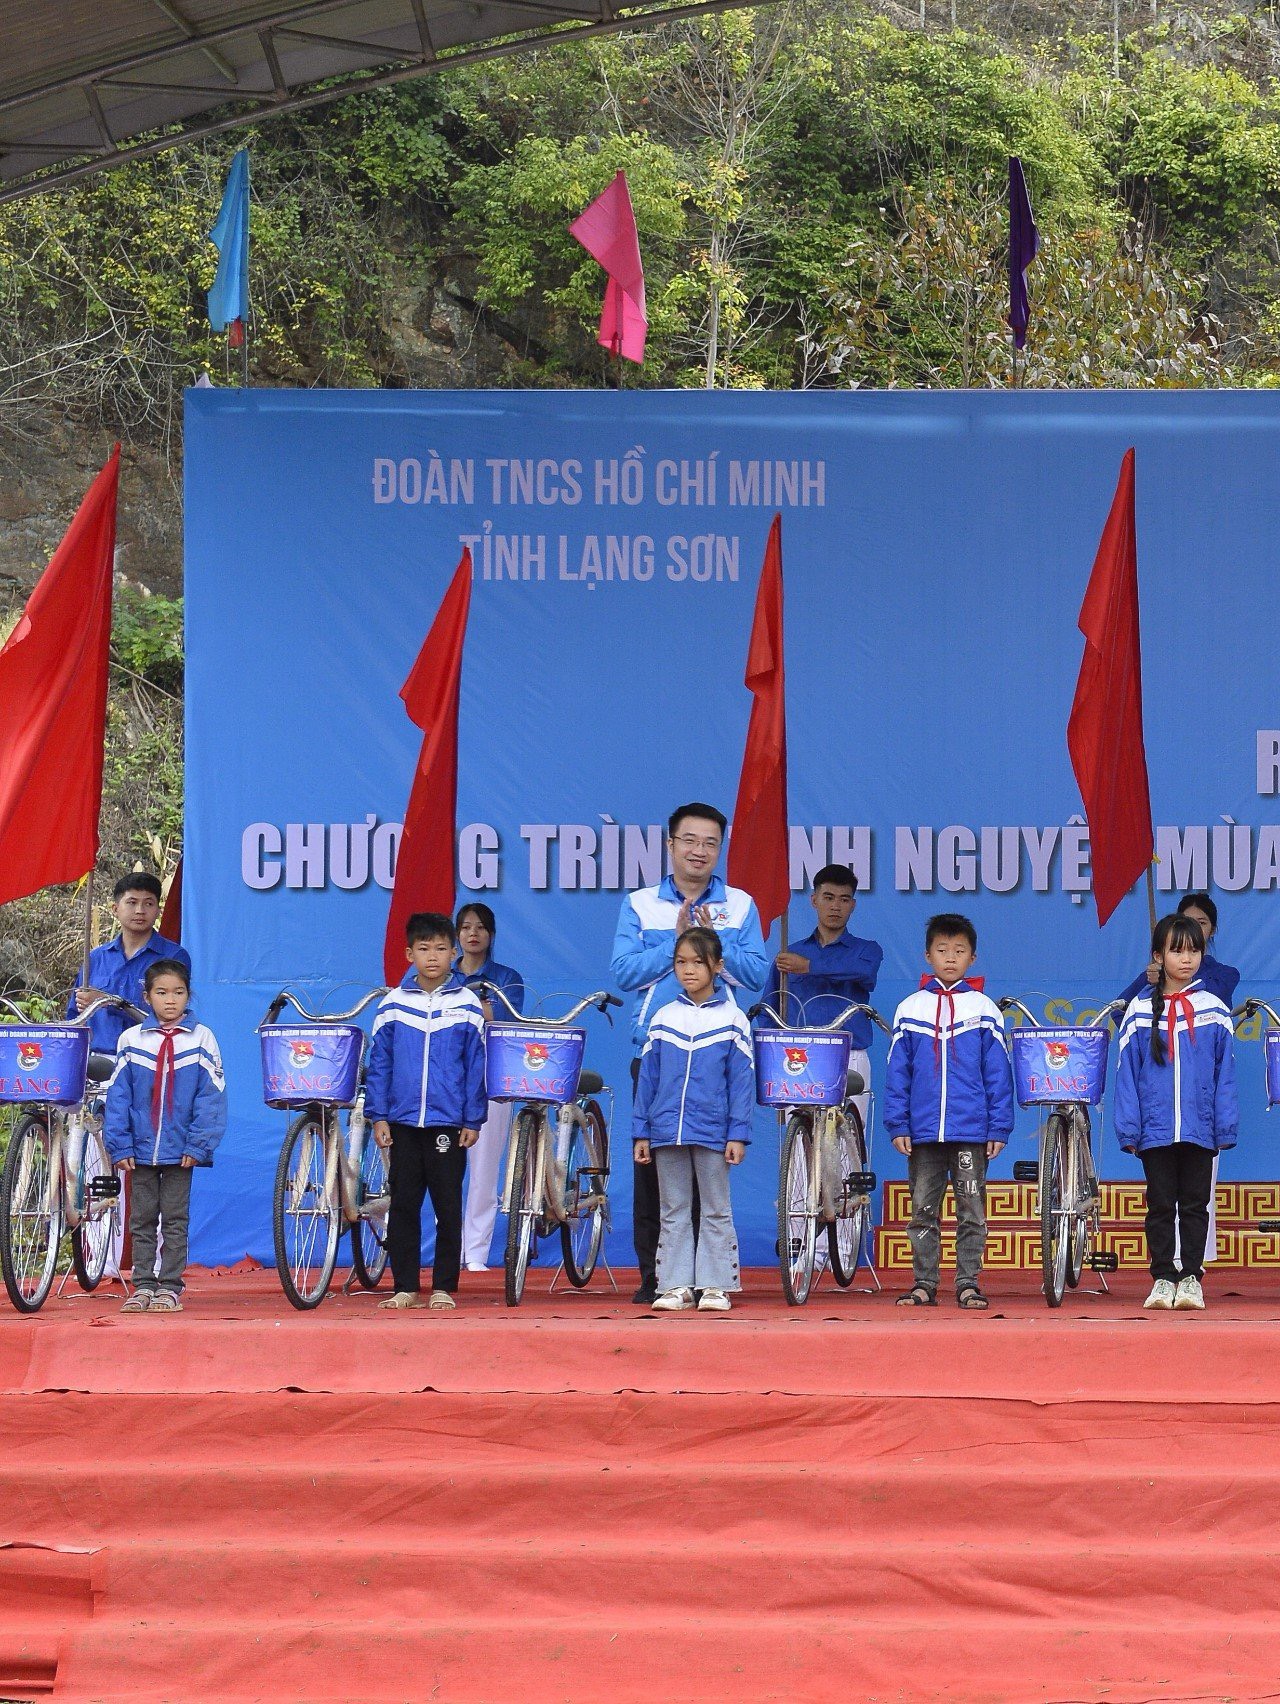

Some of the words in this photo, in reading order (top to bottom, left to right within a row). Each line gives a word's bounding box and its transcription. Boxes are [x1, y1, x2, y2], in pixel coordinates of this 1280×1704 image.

[373, 450, 474, 504] ĐOÀN
[487, 459, 583, 505] TNCS
[596, 445, 646, 505] HỒ
[656, 451, 718, 506] CHÍ
[730, 460, 825, 507] MINH
[459, 519, 546, 580] TỈNH
[560, 536, 655, 590] LẠNG
[667, 534, 739, 582] SƠN
[242, 813, 499, 889] CHƯƠG
[520, 813, 673, 889] TRÌN
[789, 826, 871, 891] NH
[895, 815, 1092, 903] NGUYỆ
